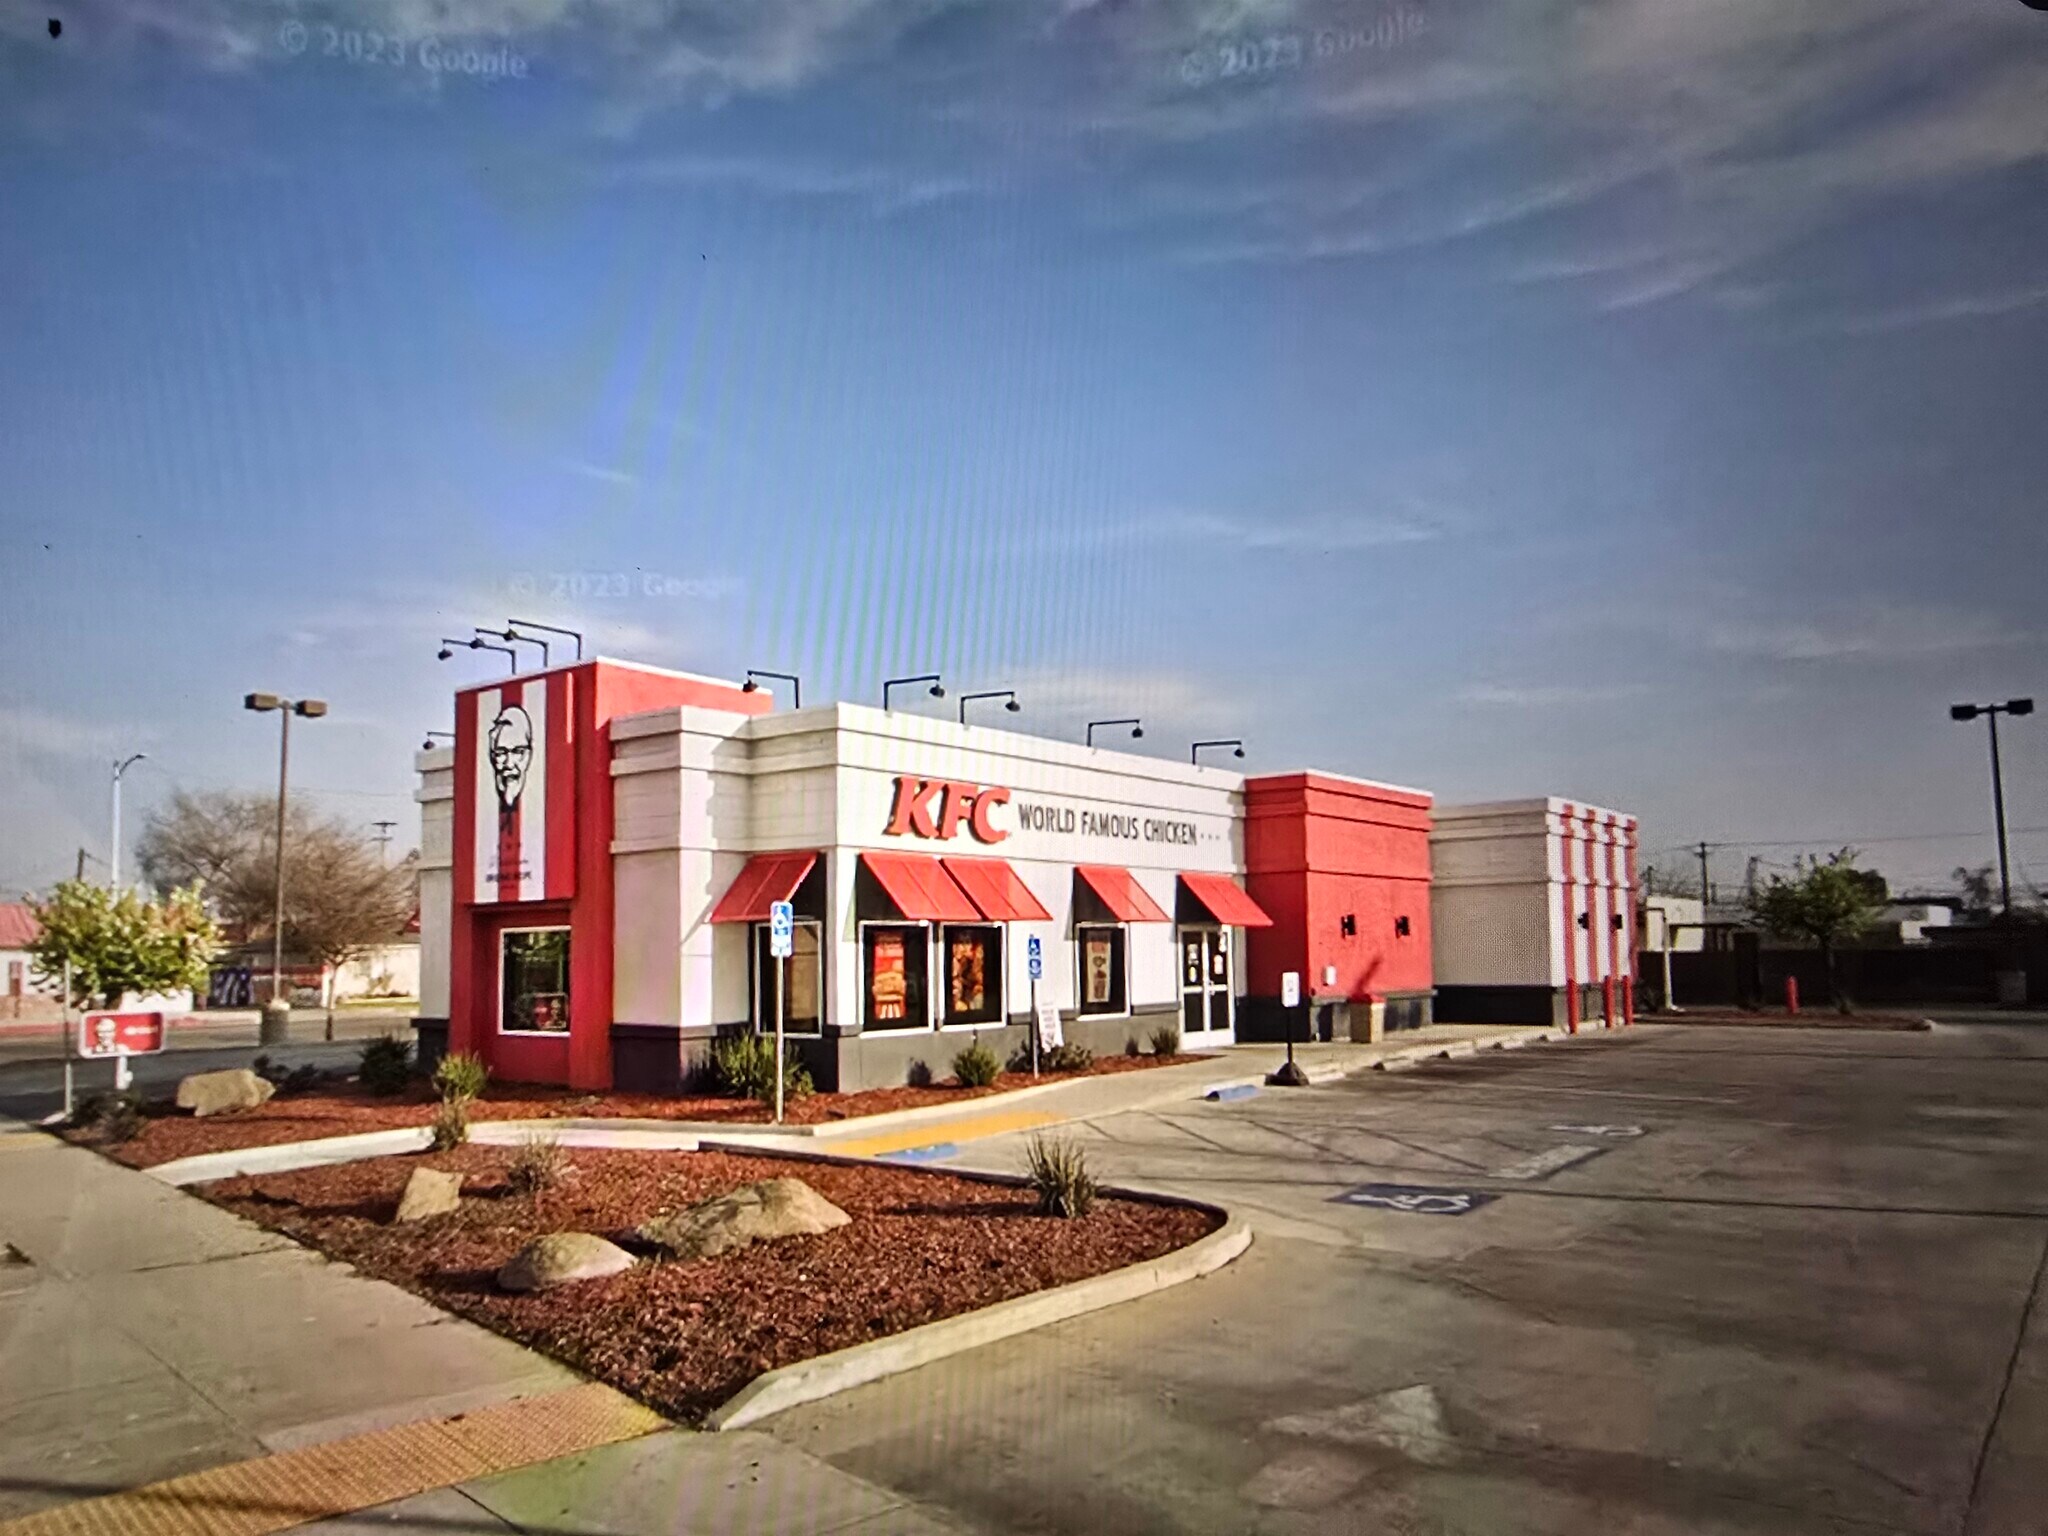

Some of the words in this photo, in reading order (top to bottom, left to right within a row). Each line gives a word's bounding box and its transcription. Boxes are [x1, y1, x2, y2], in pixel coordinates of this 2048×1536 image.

[881, 776, 1011, 845] KFC
[1018, 804, 1075, 834] WORLD
[1081, 811, 1139, 840] FAMOUS
[1144, 818, 1198, 846] CHICKEN
